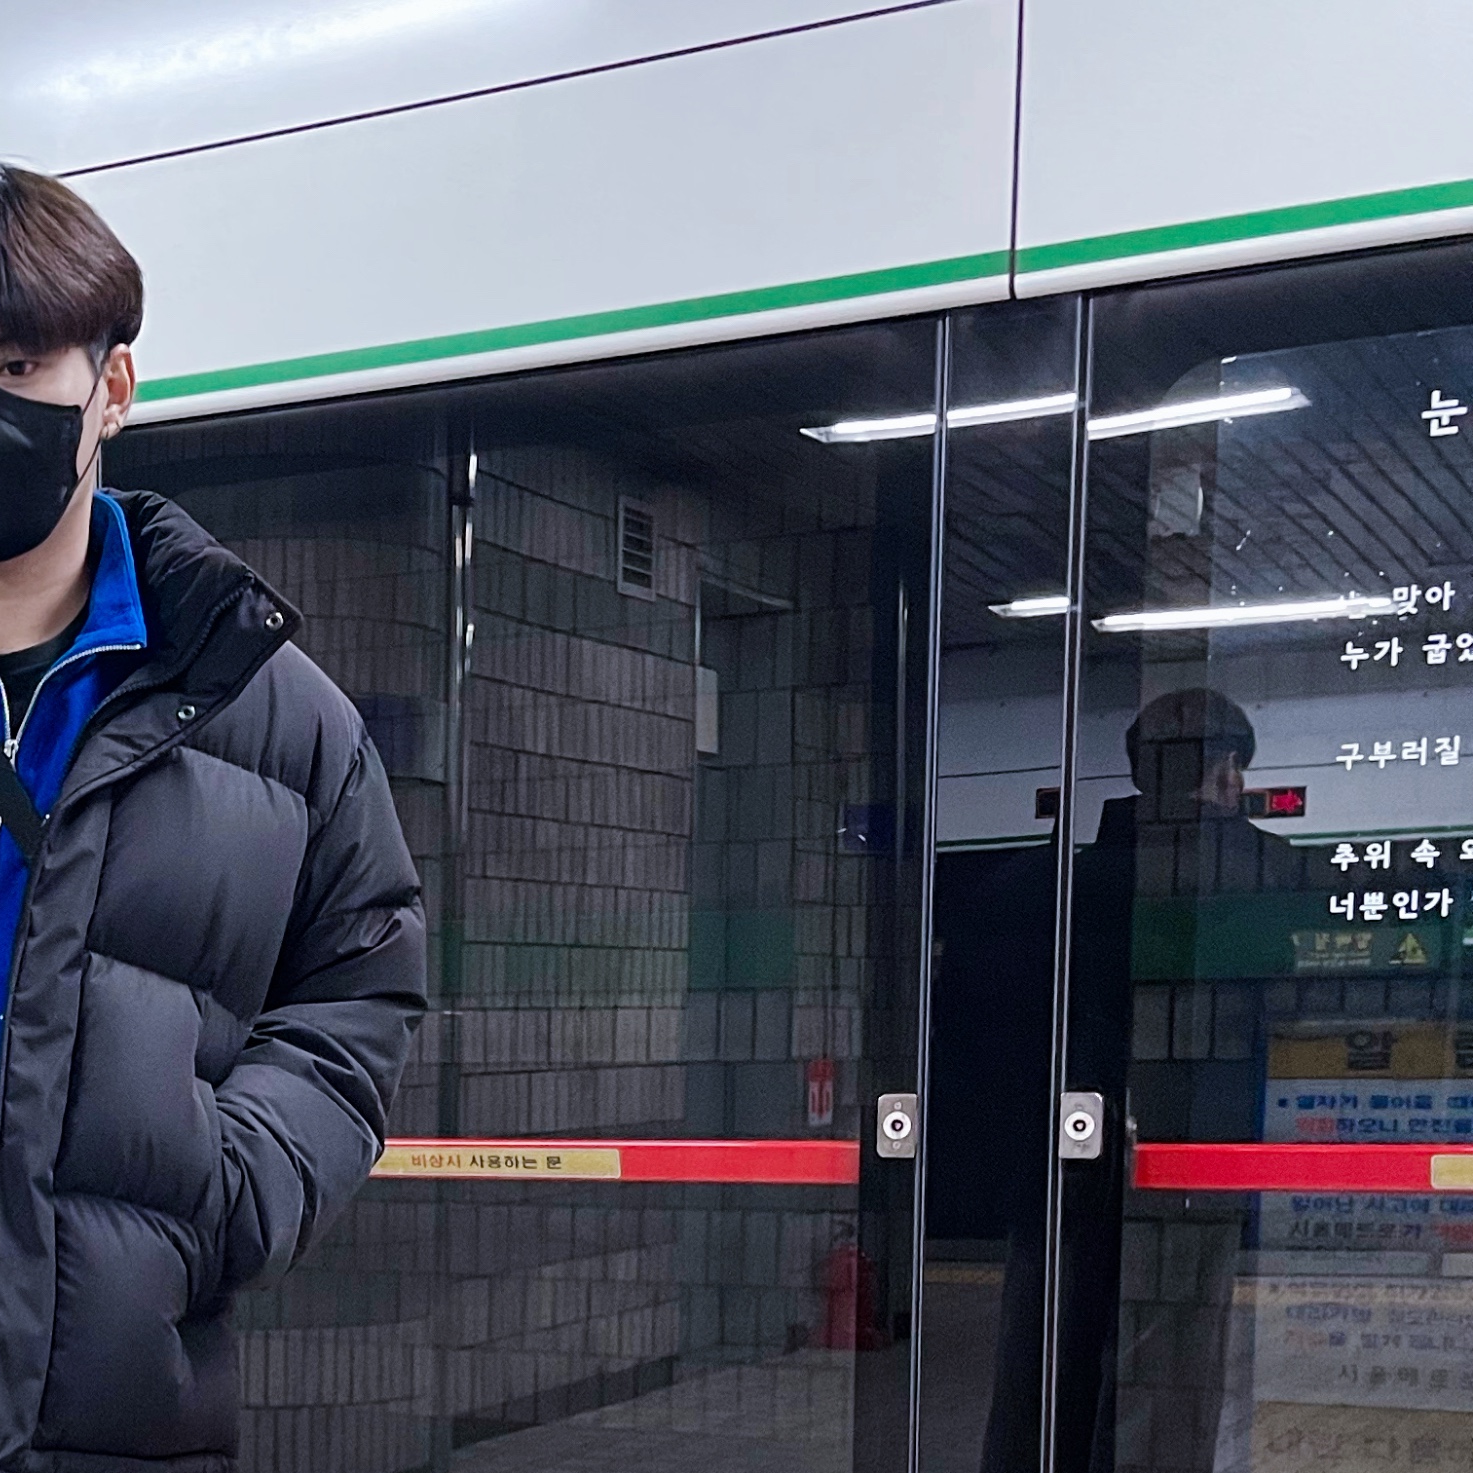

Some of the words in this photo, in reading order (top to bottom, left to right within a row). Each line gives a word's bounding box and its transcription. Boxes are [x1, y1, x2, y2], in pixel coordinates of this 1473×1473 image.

[1421, 389, 1468, 437] 눈
[1393, 581, 1456, 616] 맞아
[1340, 637, 1404, 670] 누가
[1335, 735, 1461, 771] 구부러질
[1330, 840, 1391, 872] 추위
[1410, 838, 1441, 869] 속
[1329, 888, 1454, 921] 너뿐인가
[411, 1153, 461, 1169] 비상시
[469, 1154, 538, 1170] 사용하는
[546, 1155, 562, 1170] 문
